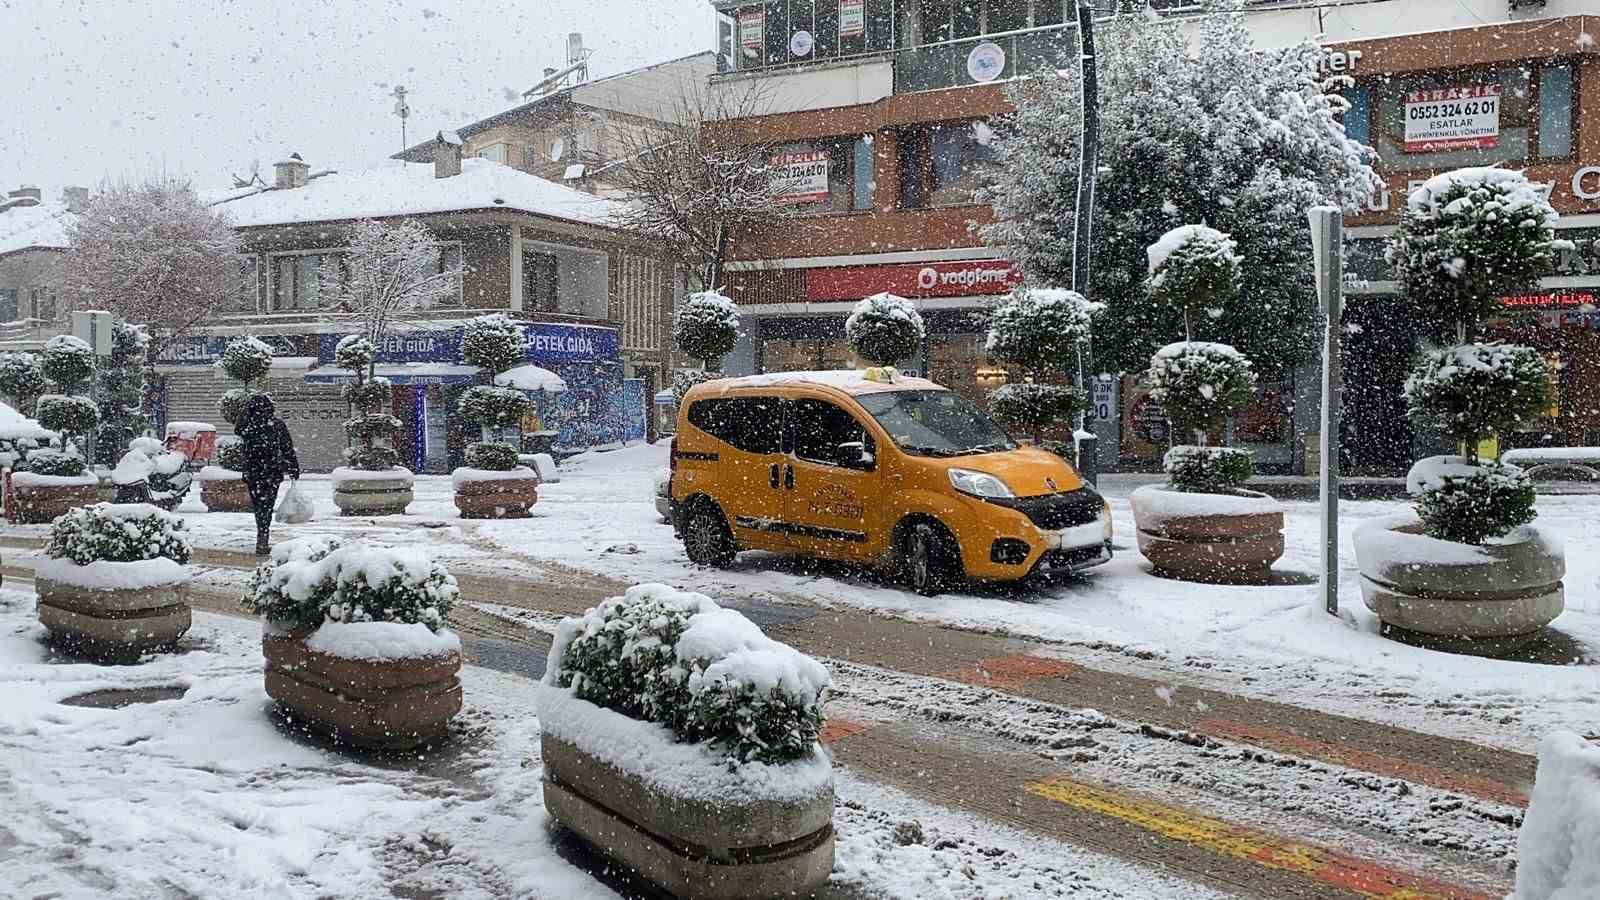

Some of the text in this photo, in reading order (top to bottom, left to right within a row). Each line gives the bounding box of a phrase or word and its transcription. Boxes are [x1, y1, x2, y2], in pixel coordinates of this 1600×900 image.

[1410, 101, 1495, 120] 0552 324 62 01
[1430, 119, 1473, 130] ESATLAR
[939, 267, 1008, 287] vodafone
[406, 338, 435, 353] GIDA
[527, 334, 594, 355] PETEK GIDA
